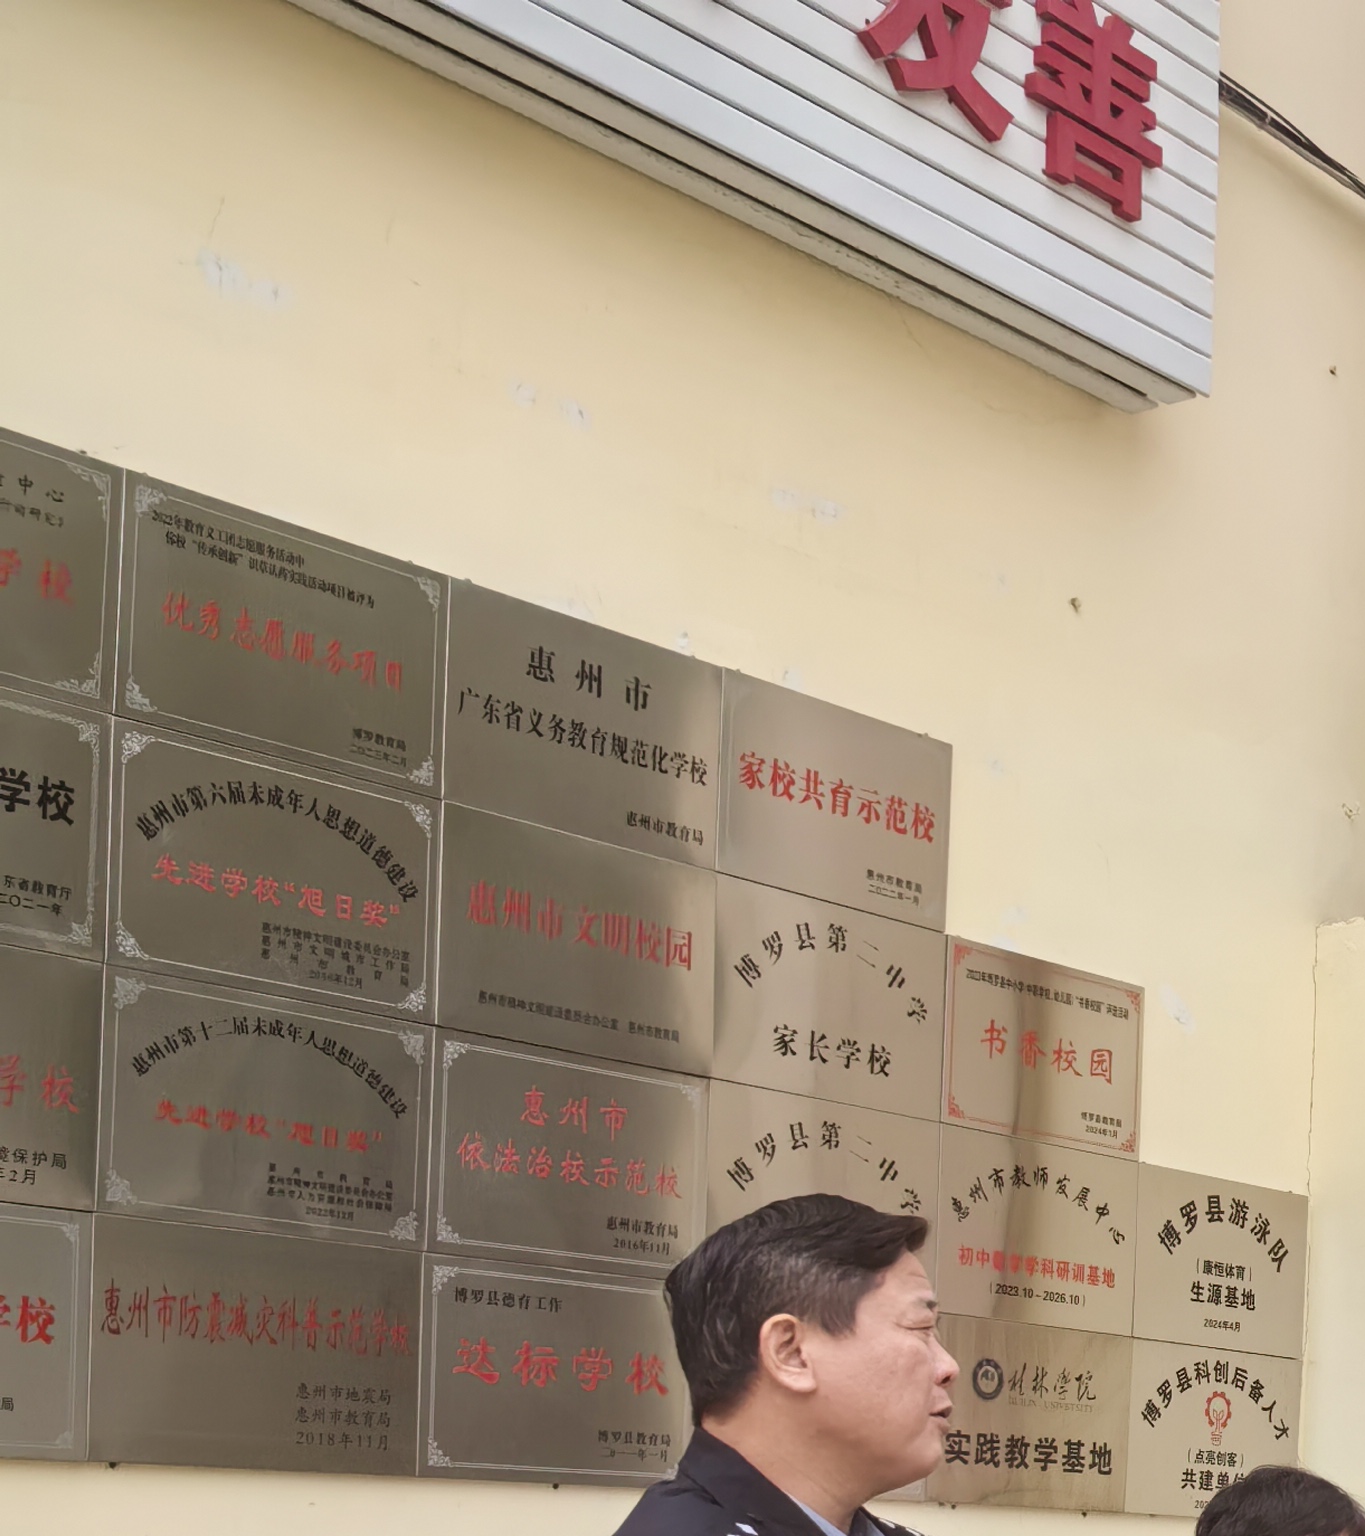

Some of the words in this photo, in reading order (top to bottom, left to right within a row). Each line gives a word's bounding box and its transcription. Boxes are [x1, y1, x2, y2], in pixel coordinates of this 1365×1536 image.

[161, 590, 403, 692] 优秀志愿服务项目
[526, 645, 652, 712] 惠州市
[457, 687, 708, 787] 广东省义务教育规范化学校
[738, 751, 936, 844] 家校共育示范校
[135, 780, 420, 904] 惠州市第六届未成年人思想道德建设
[467, 878, 693, 972] 惠州市文明校园
[733, 922, 928, 1025] 博罗县第二中学
[131, 1015, 408, 1120] 惠州市第十二届未成年人思想道德建设
[772, 1023, 892, 1078] 家长学校
[980, 1018, 1114, 1086] 书香校园
[519, 1085, 628, 1142] 惠州市
[456, 1131, 683, 1200] 依法治校示范校
[726, 1119, 923, 1214] 博罗县第二中学
[1157, 1194, 1290, 1274] 博罗县游泳队
[100, 1277, 414, 1357] 惠州市防震减灾科普示范学校
[453, 1285, 563, 1314] 博罗县德育工作
[1189, 1280, 1257, 1311] 生源基地
[1203, 1318, 1241, 1333] 2024年4月
[451, 1336, 669, 1397] 达标学校
[1140, 1359, 1290, 1441] 博罗县科创后备人才
[944, 1429, 1113, 1476] 实践教学基地
